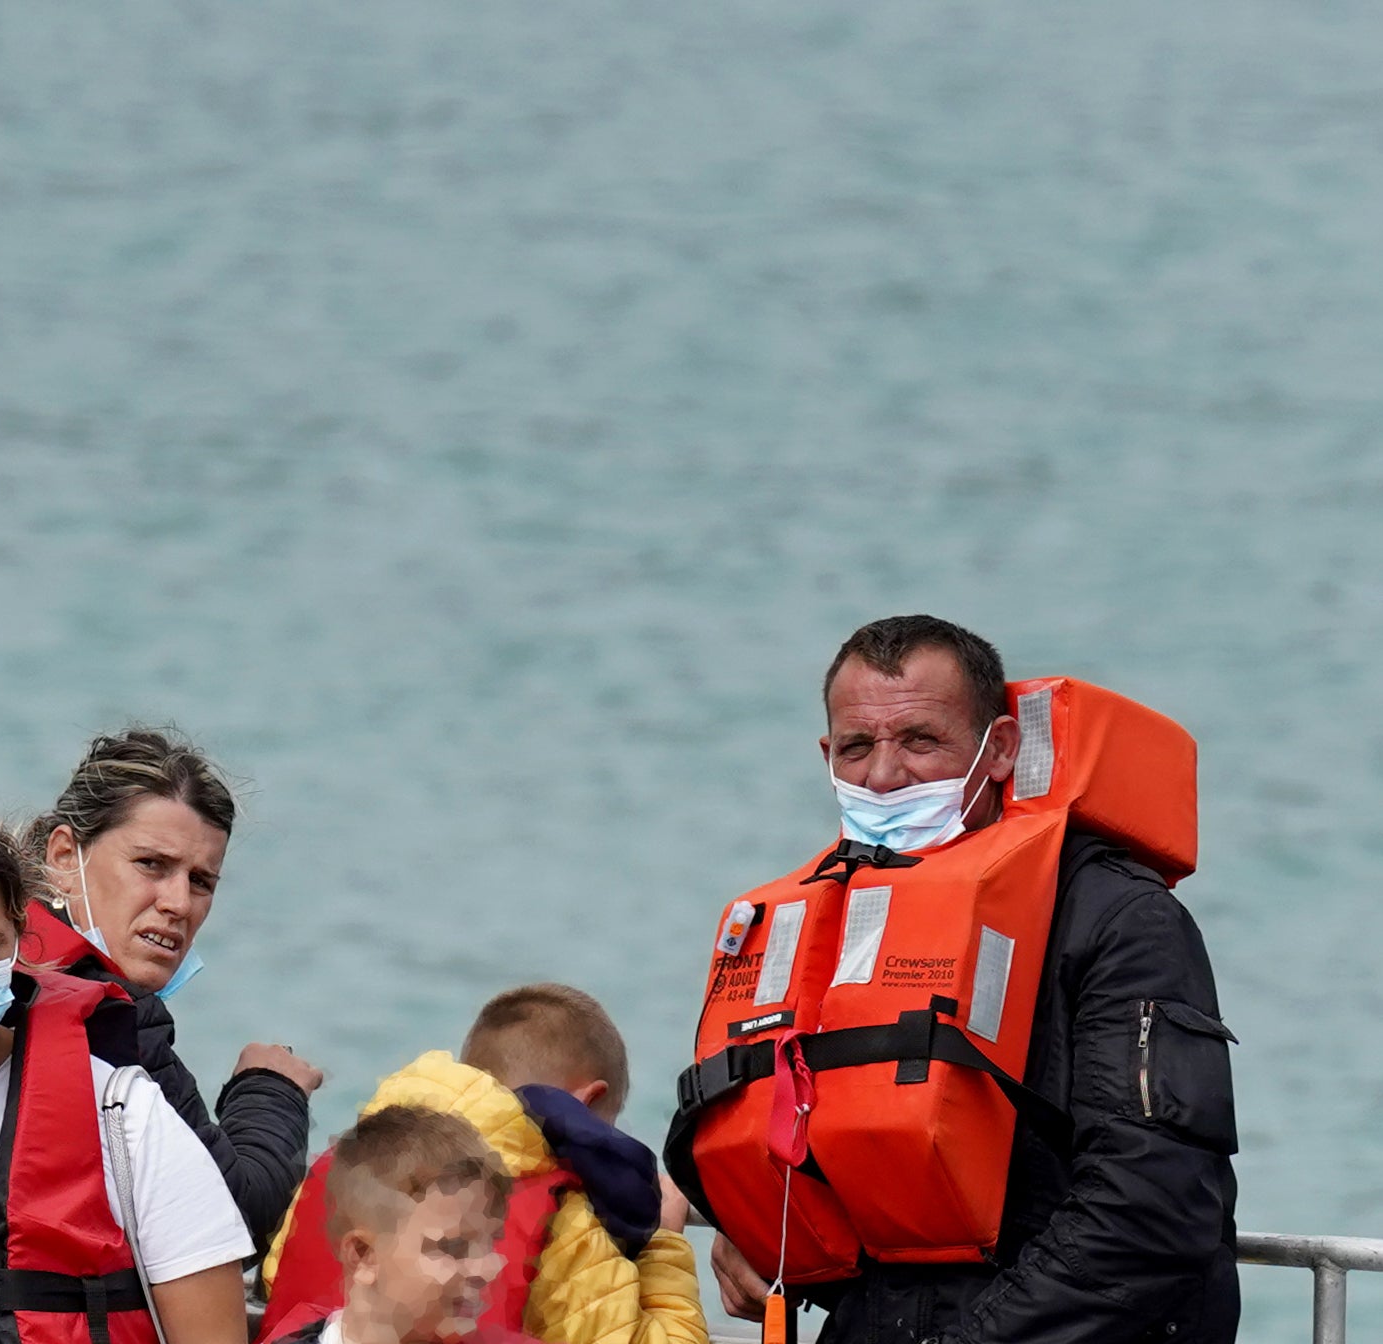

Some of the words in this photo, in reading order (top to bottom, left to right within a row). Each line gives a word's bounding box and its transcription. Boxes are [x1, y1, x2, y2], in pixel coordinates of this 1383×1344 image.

[885, 955, 957, 969] Crewsaver
[882, 969, 925, 980] Premier
[927, 969, 954, 980] 2010
